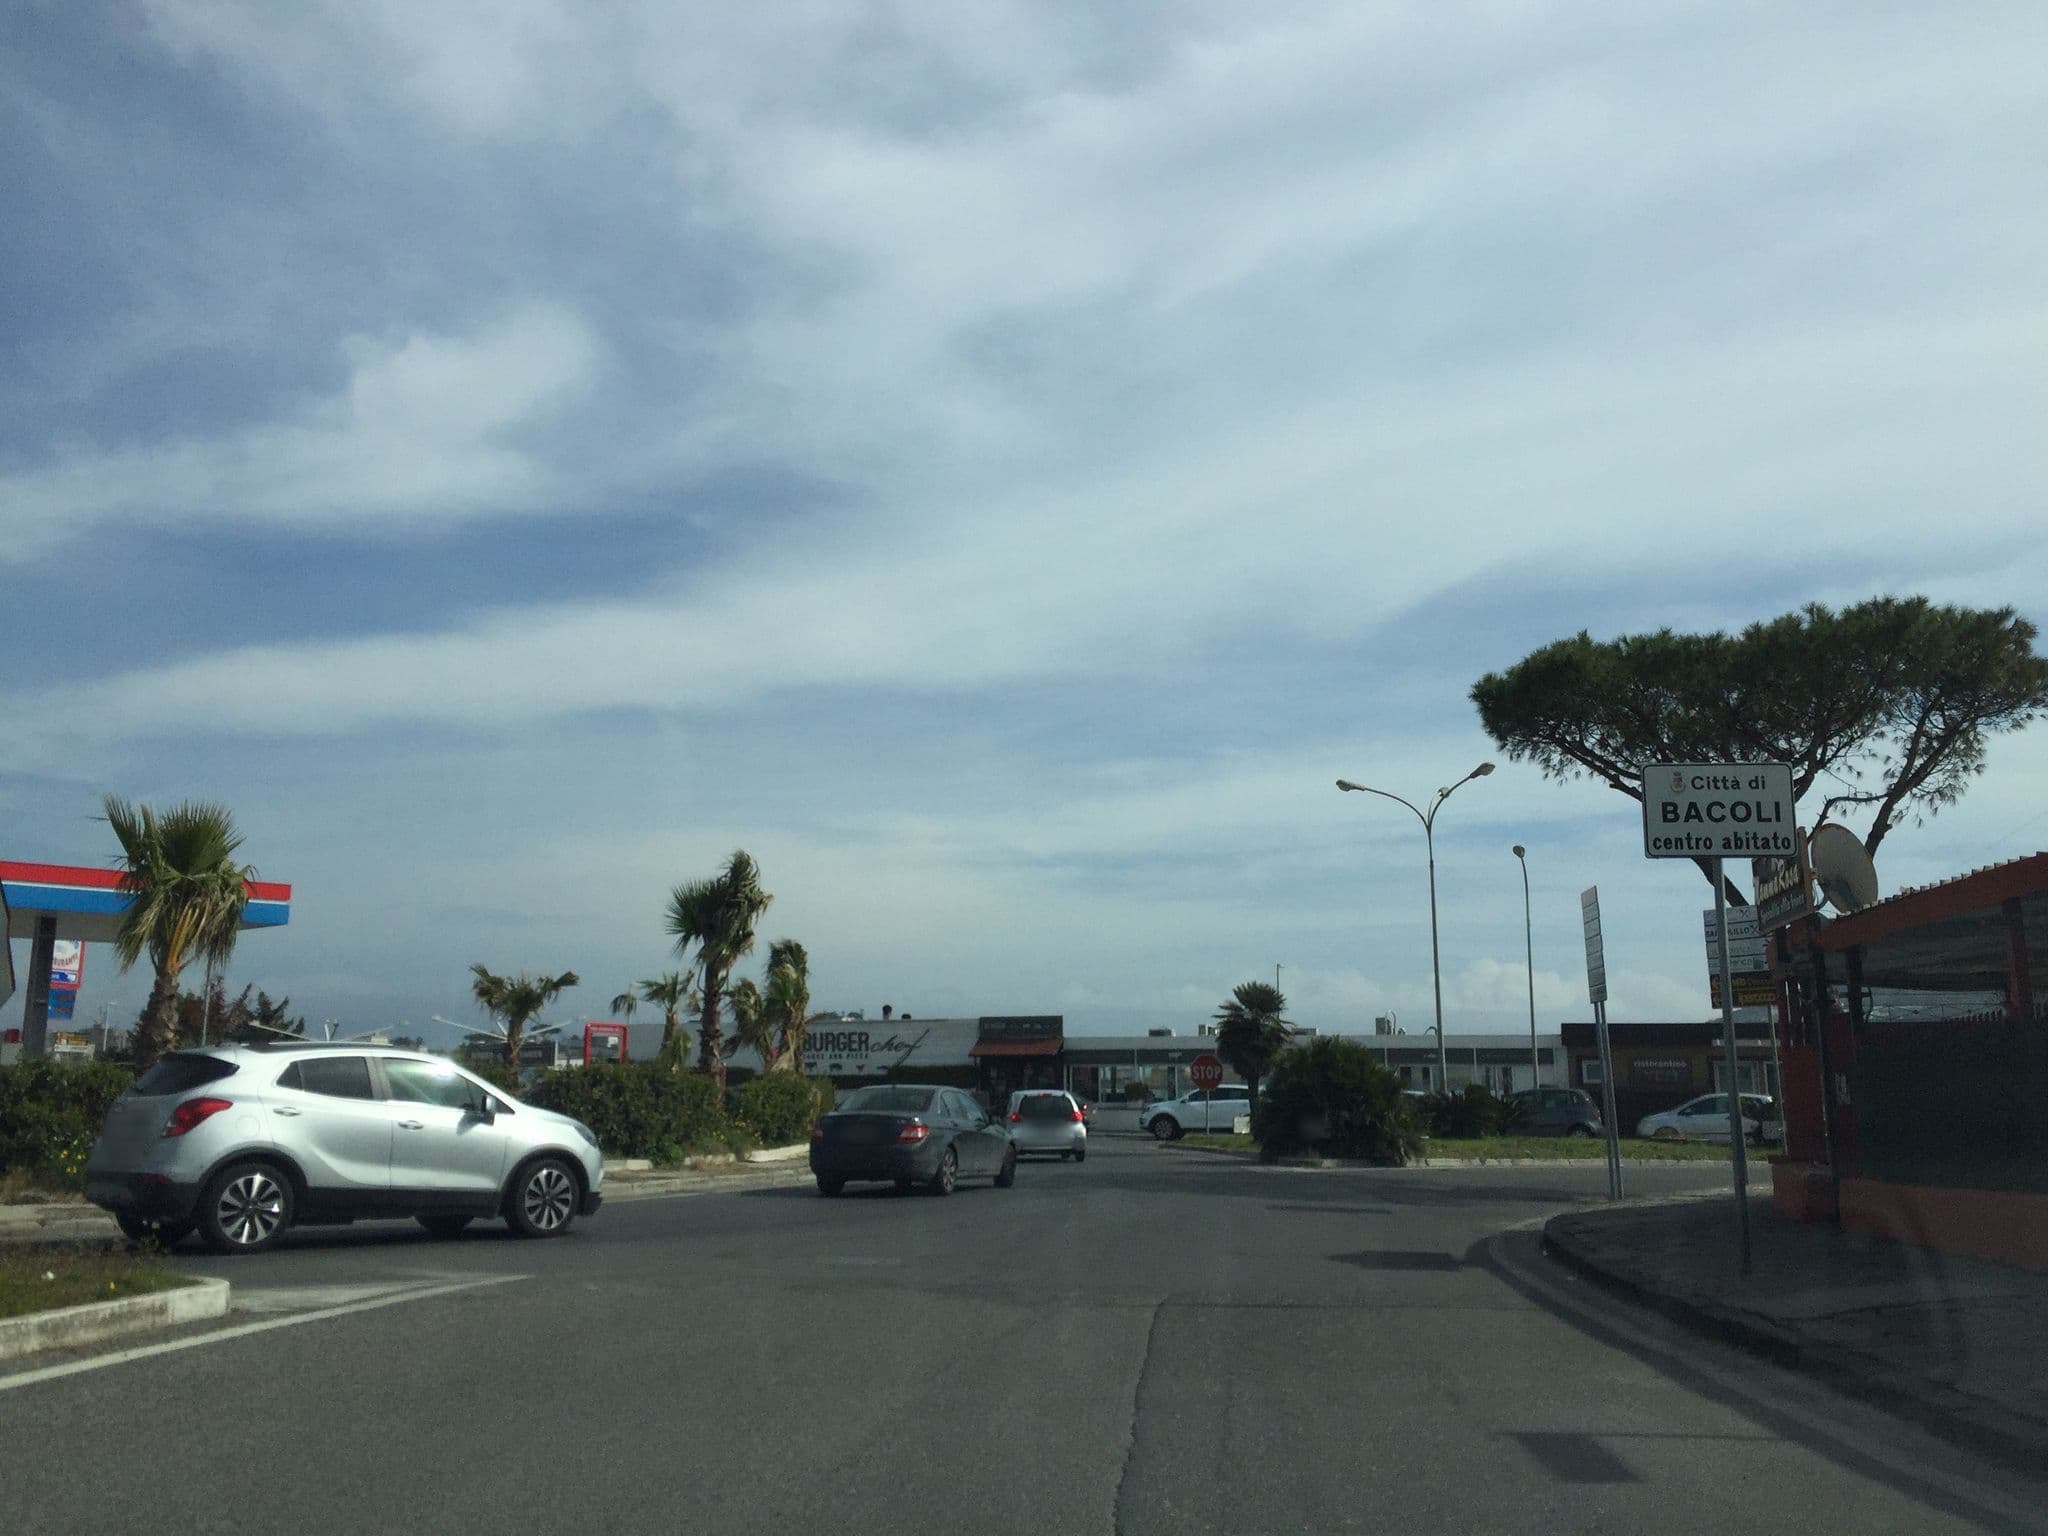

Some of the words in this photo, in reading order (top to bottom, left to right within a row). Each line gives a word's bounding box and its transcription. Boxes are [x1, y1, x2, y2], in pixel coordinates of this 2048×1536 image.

[1691, 775, 1741, 790] Città
[1748, 775, 1766, 790] di
[1661, 801, 1782, 823] BACOLI
[1652, 832, 1714, 850] centro
[1721, 831, 1791, 850] abitato
[803, 1031, 870, 1053] BURGER
[1192, 1065, 1222, 1080] STOP
